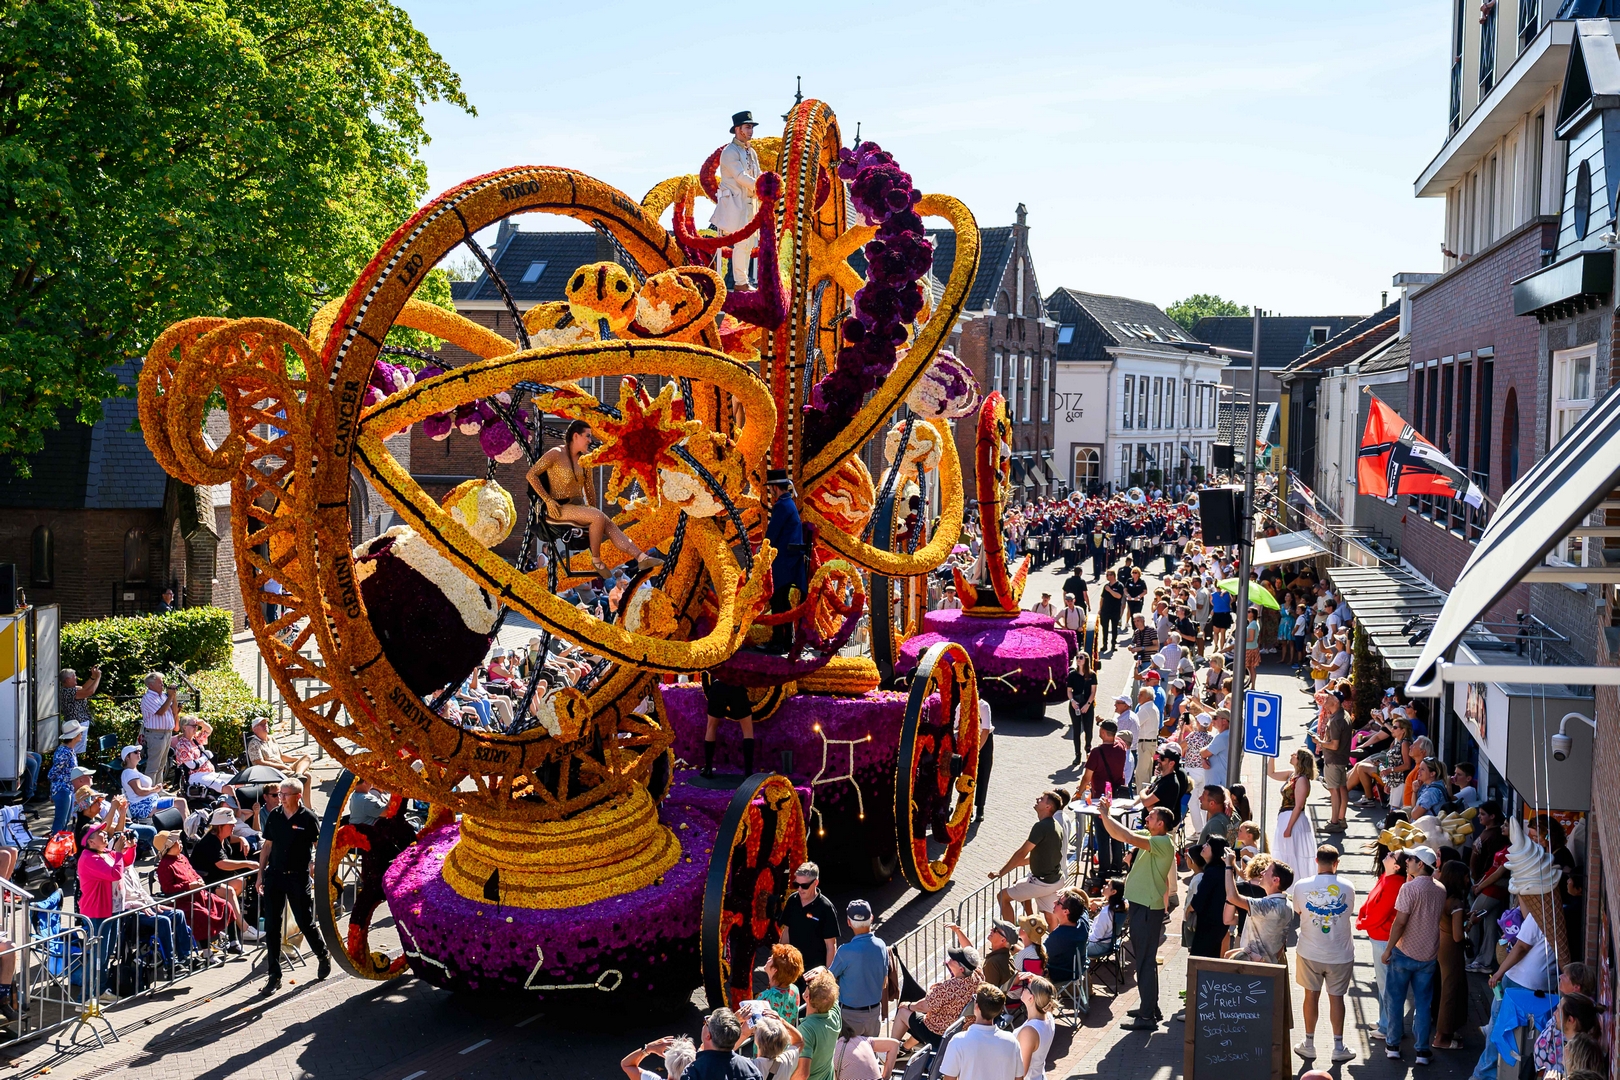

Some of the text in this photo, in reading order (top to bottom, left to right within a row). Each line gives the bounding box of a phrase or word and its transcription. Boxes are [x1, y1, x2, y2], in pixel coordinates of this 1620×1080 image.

[500, 179, 540, 201] VIRGO
[611, 192, 643, 222] LIBRA
[397, 253, 424, 287] LEO
[334, 381, 360, 458] CANCER
[335, 554, 360, 619] GEMINI
[389, 686, 433, 733] TAURUS
[1253, 697, 1271, 727] P
[475, 748, 510, 764] ARIES
[555, 731, 594, 760] PISCES
[1200, 1011, 1216, 1021] met
[1220, 1039, 1233, 1047] en
